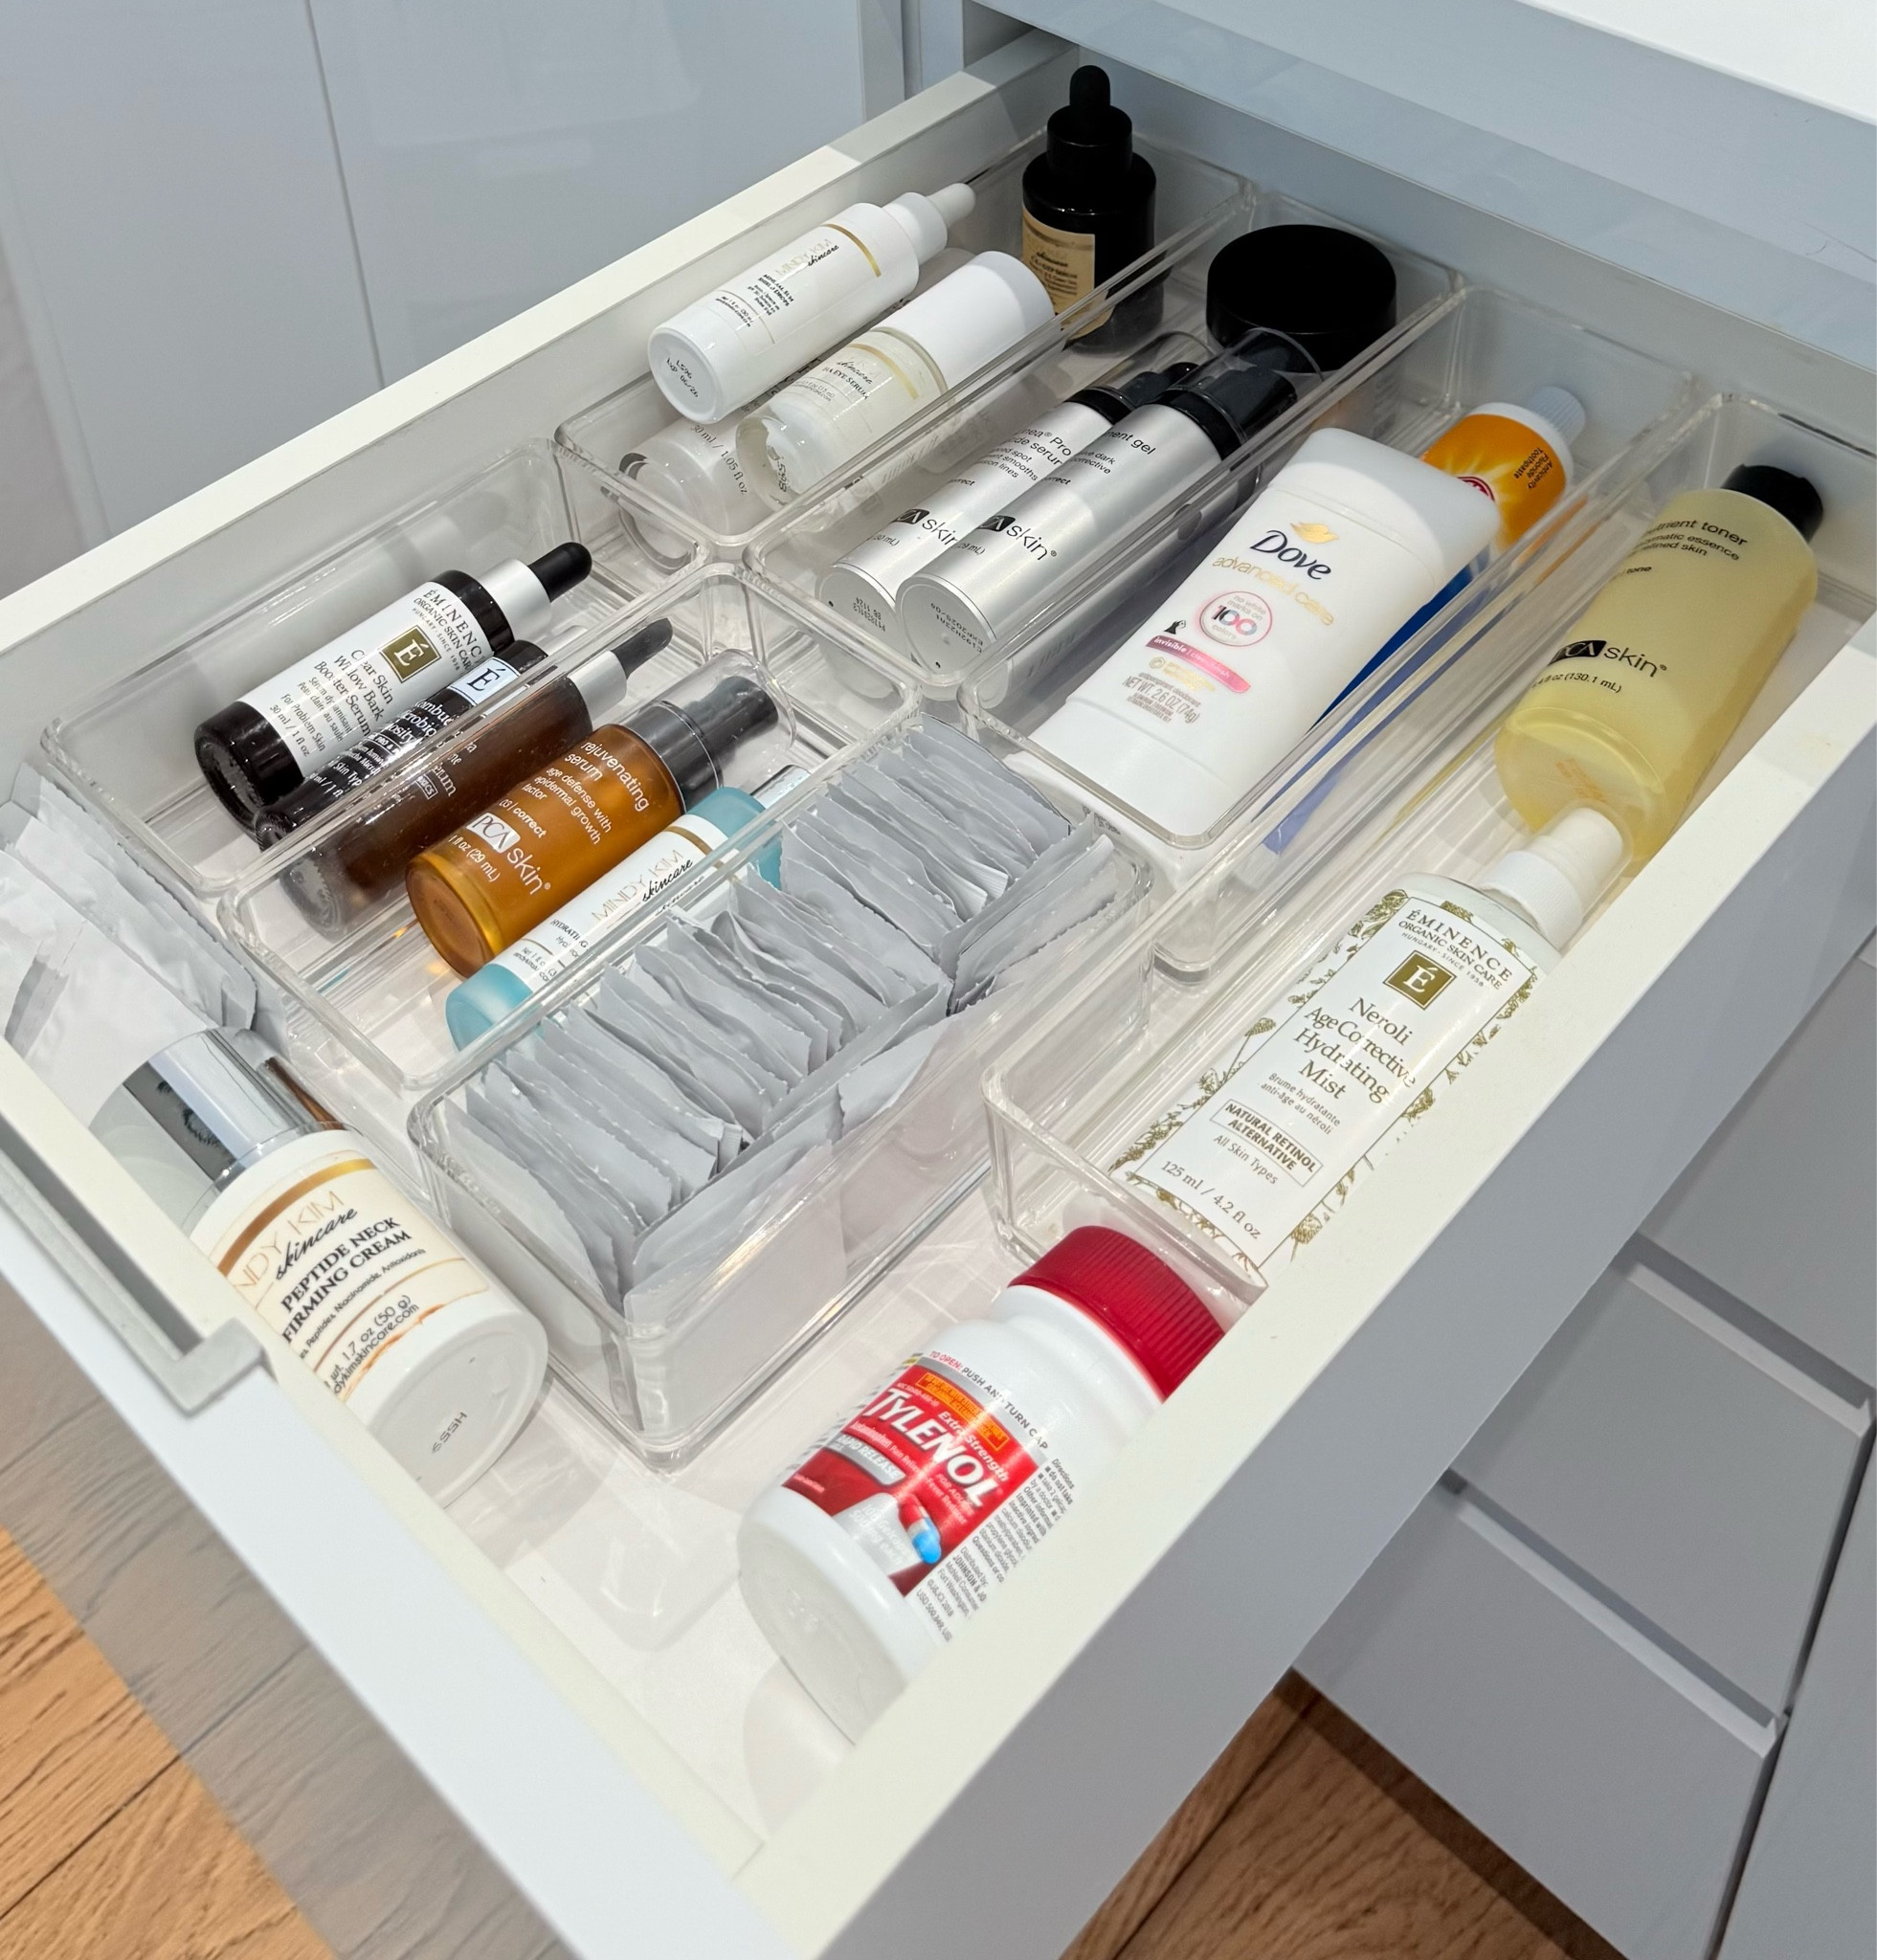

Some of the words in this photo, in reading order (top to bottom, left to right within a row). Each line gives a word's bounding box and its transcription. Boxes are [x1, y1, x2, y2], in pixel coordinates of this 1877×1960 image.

[833, 369, 847, 382] EYE
[720, 450, 738, 473] 1.05
[1011, 450, 1033, 463] spot
[1051, 436, 1071, 457] Pro
[1094, 452, 1116, 465] dark
[1130, 437, 1156, 456] gel
[1513, 447, 1544, 479] Toothpaste
[998, 461, 1019, 479] lines
[1002, 455, 1039, 480] smooths
[1249, 529, 1331, 580] Dove
[1681, 544, 1708, 556] skin
[1687, 536, 1739, 561] essence
[1701, 522, 1748, 546] toner
[1212, 556, 1299, 595] advanced
[413, 597, 448, 626] ORGANIC
[444, 626, 462, 649] SKIN
[459, 649, 474, 670] CAR
[1212, 605, 1258, 636] 100
[394, 638, 430, 667] É
[1154, 636, 1187, 653] invisible
[350, 649, 377, 676] Cear
[373, 675, 393, 705] Skin
[467, 668, 506, 693] É
[1122, 676, 1142, 688] NET
[1166, 695, 1182, 709] OZ
[1565, 673, 1598, 683] (130.1
[1600, 679, 1621, 693] mL)
[324, 712, 333, 724] au
[346, 694, 371, 737] Serum
[363, 690, 385, 722] Bark
[269, 704, 281, 715] 30
[278, 713, 291, 725] ml
[301, 746, 310, 758] oz
[291, 704, 317, 734] Problem
[312, 732, 326, 752] Skin
[565, 753, 603, 781] serum
[581, 742, 650, 812] rejuvenating
[512, 807, 547, 839] correct
[534, 776, 576, 807] epidermal
[570, 806, 601, 845] growth
[562, 775, 595, 809] defense
[593, 808, 612, 833] with
[472, 814, 511, 850] PCA
[458, 841, 472, 852] oz
[466, 848, 486, 863] (29
[480, 861, 501, 882] mL)
[642, 859, 694, 902] skincare
[592, 874, 649, 923] MINDY
[649, 849, 684, 877] KIM
[550, 919, 589, 948] HYDRATIG
[1401, 932, 1438, 954] HUNGARY
[1441, 953, 1464, 971] SINCE
[1406, 909, 1512, 982] ÉMINENCE
[1398, 921, 1448, 947] ORGANIC
[1447, 945, 1475, 966] SKIN
[1474, 964, 1502, 990] CARE
[1403, 965, 1439, 993] É
[1349, 997, 1413, 1046] Neroli
[1294, 1027, 1390, 1103] Hydrating
[1338, 1021, 1417, 1088] Corective
[1268, 1073, 1297, 1093] Brume
[1296, 1088, 1341, 1126] hydratante
[1299, 1059, 1347, 1100] Mist
[1261, 1082, 1294, 1106] anti-âge
[1294, 1104, 1307, 1114] au
[1307, 1111, 1332, 1136] néroli
[1225, 1103, 1272, 1137] NATURAL
[1273, 1132, 1318, 1172] RETINOL
[1228, 1119, 1297, 1171] ALTERNATIVE
[1214, 1135, 1227, 1147] All
[1227, 1142, 1250, 1162] Skin
[1249, 1157, 1279, 1185] Types
[1161, 1161, 1185, 1177] 125
[1182, 1173, 1204, 1191] ml
[1213, 1195, 1235, 1214] 4.2
[1232, 1211, 1246, 1224] fl
[1243, 1223, 1262, 1239] oz
[233, 1231, 282, 1287] NDY
[287, 1191, 345, 1235] KIM
[276, 1208, 357, 1281] skincare
[280, 1244, 350, 1313] PEPTIDE
[348, 1216, 401, 1249] NECK
[382, 1248, 426, 1274] Antioxidants
[281, 1267, 349, 1345] FIRMING
[349, 1229, 413, 1270] CREAM
[335, 1303, 420, 1394] dykimskincare.com
[342, 1341, 357, 1361] 1.7
[360, 1327, 375, 1343] oz
[374, 1306, 395, 1326] (50
[397, 1295, 411, 1308] g)
[961, 1367, 986, 1387] PUSH
[1004, 1402, 1031, 1429] TURN
[860, 1444, 901, 1480] RELEASE
[861, 1389, 1002, 1508] TYLENOL
[964, 1434, 1010, 1481] Strength
[1052, 1458, 1075, 1490] Directions
[952, 1554, 978, 1587] JOHNSON
